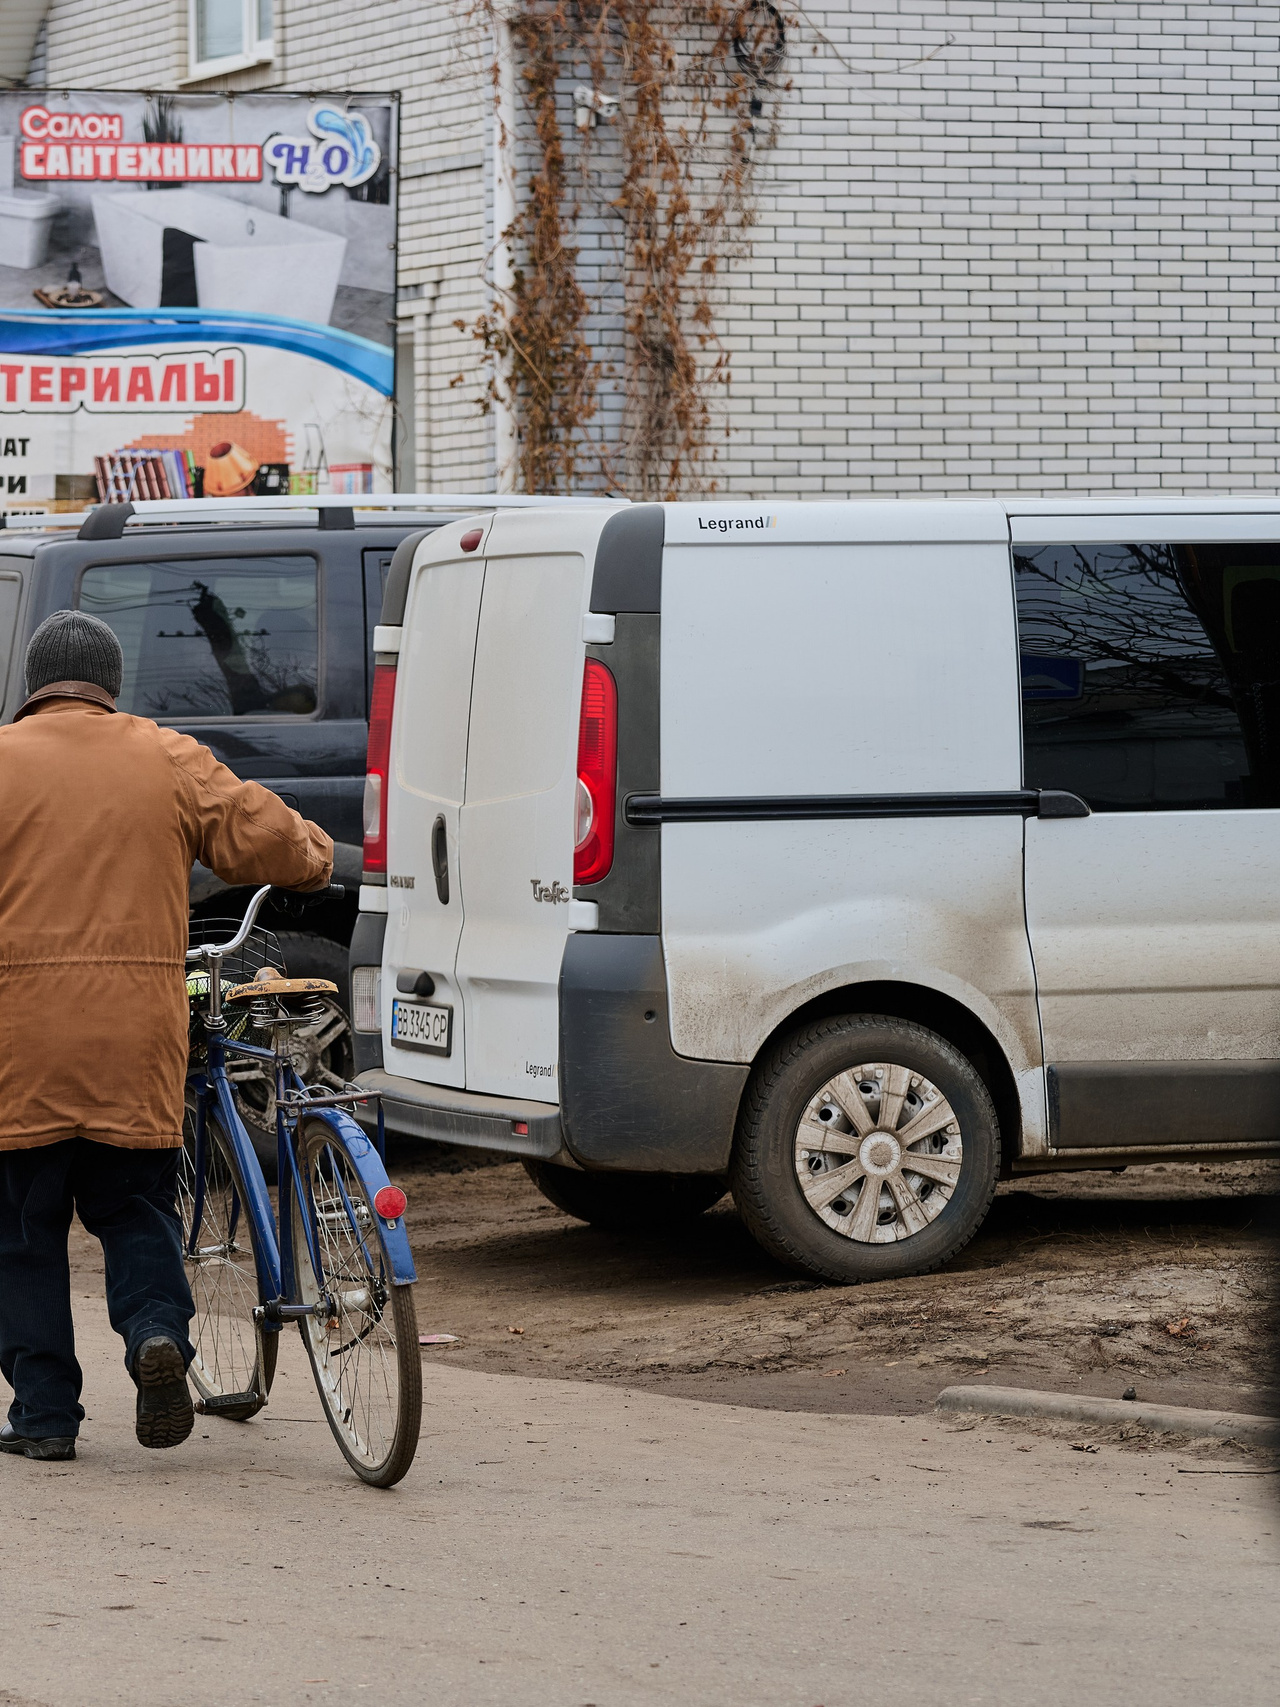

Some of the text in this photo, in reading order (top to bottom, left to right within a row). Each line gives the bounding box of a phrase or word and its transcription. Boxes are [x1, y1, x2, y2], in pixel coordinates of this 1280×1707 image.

[22, 109, 121, 140] Салон
[24, 145, 261, 178] САНТЕХНИКИ
[698, 516, 764, 533] Legrand
[530, 879, 570, 905] Trafic
[397, 1007, 447, 1043] BB 3345 CP
[525, 1061, 552, 1079] Legrand
